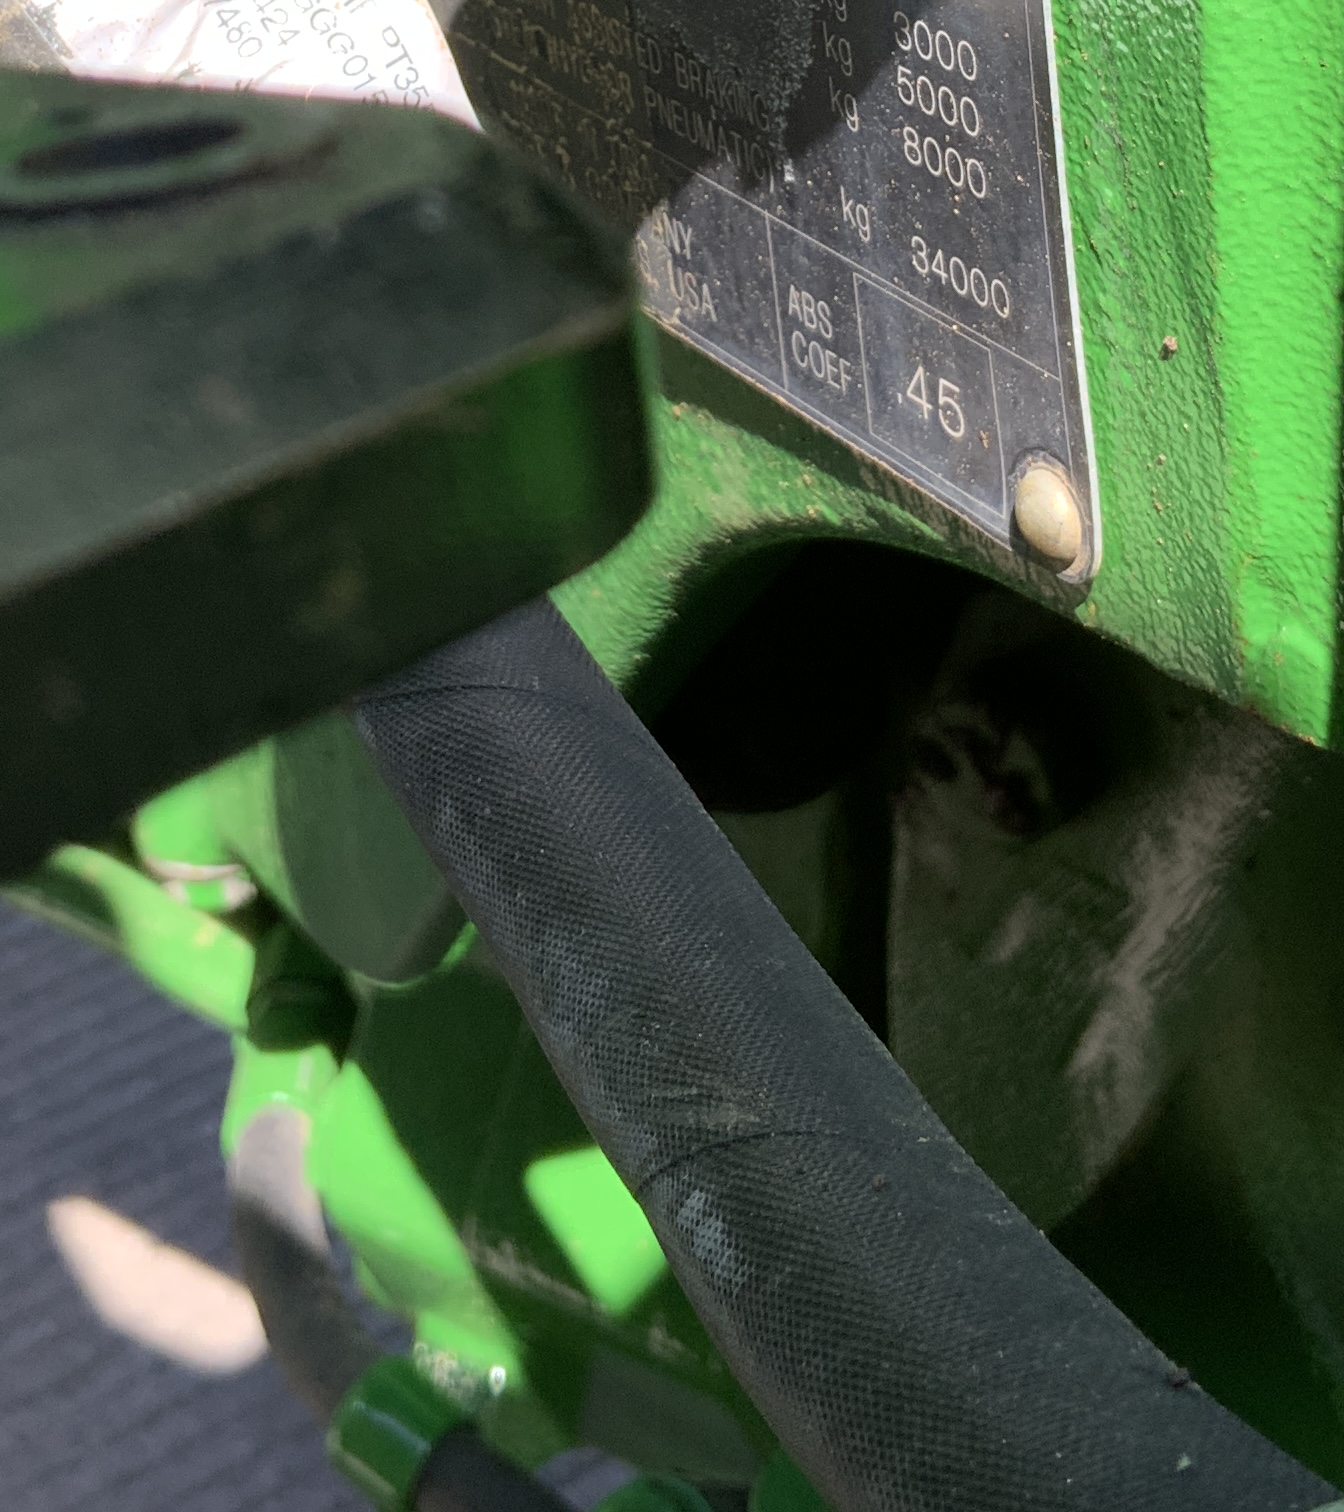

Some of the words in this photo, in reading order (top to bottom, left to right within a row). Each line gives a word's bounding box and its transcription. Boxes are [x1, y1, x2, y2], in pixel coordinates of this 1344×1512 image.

[381, 25, 436, 109] PT35
[822, 22, 853, 77] kg
[897, 65, 981, 137] 5000
[893, 11, 977, 82] 3000
[828, 76, 860, 133] kg
[903, 126, 986, 199] 8000
[840, 186, 871, 242] kg
[910, 236, 1010, 319] 34000
[788, 284, 833, 339] ABS
[791, 331, 852, 396] COEF
[896, 365, 965, 438] .45
